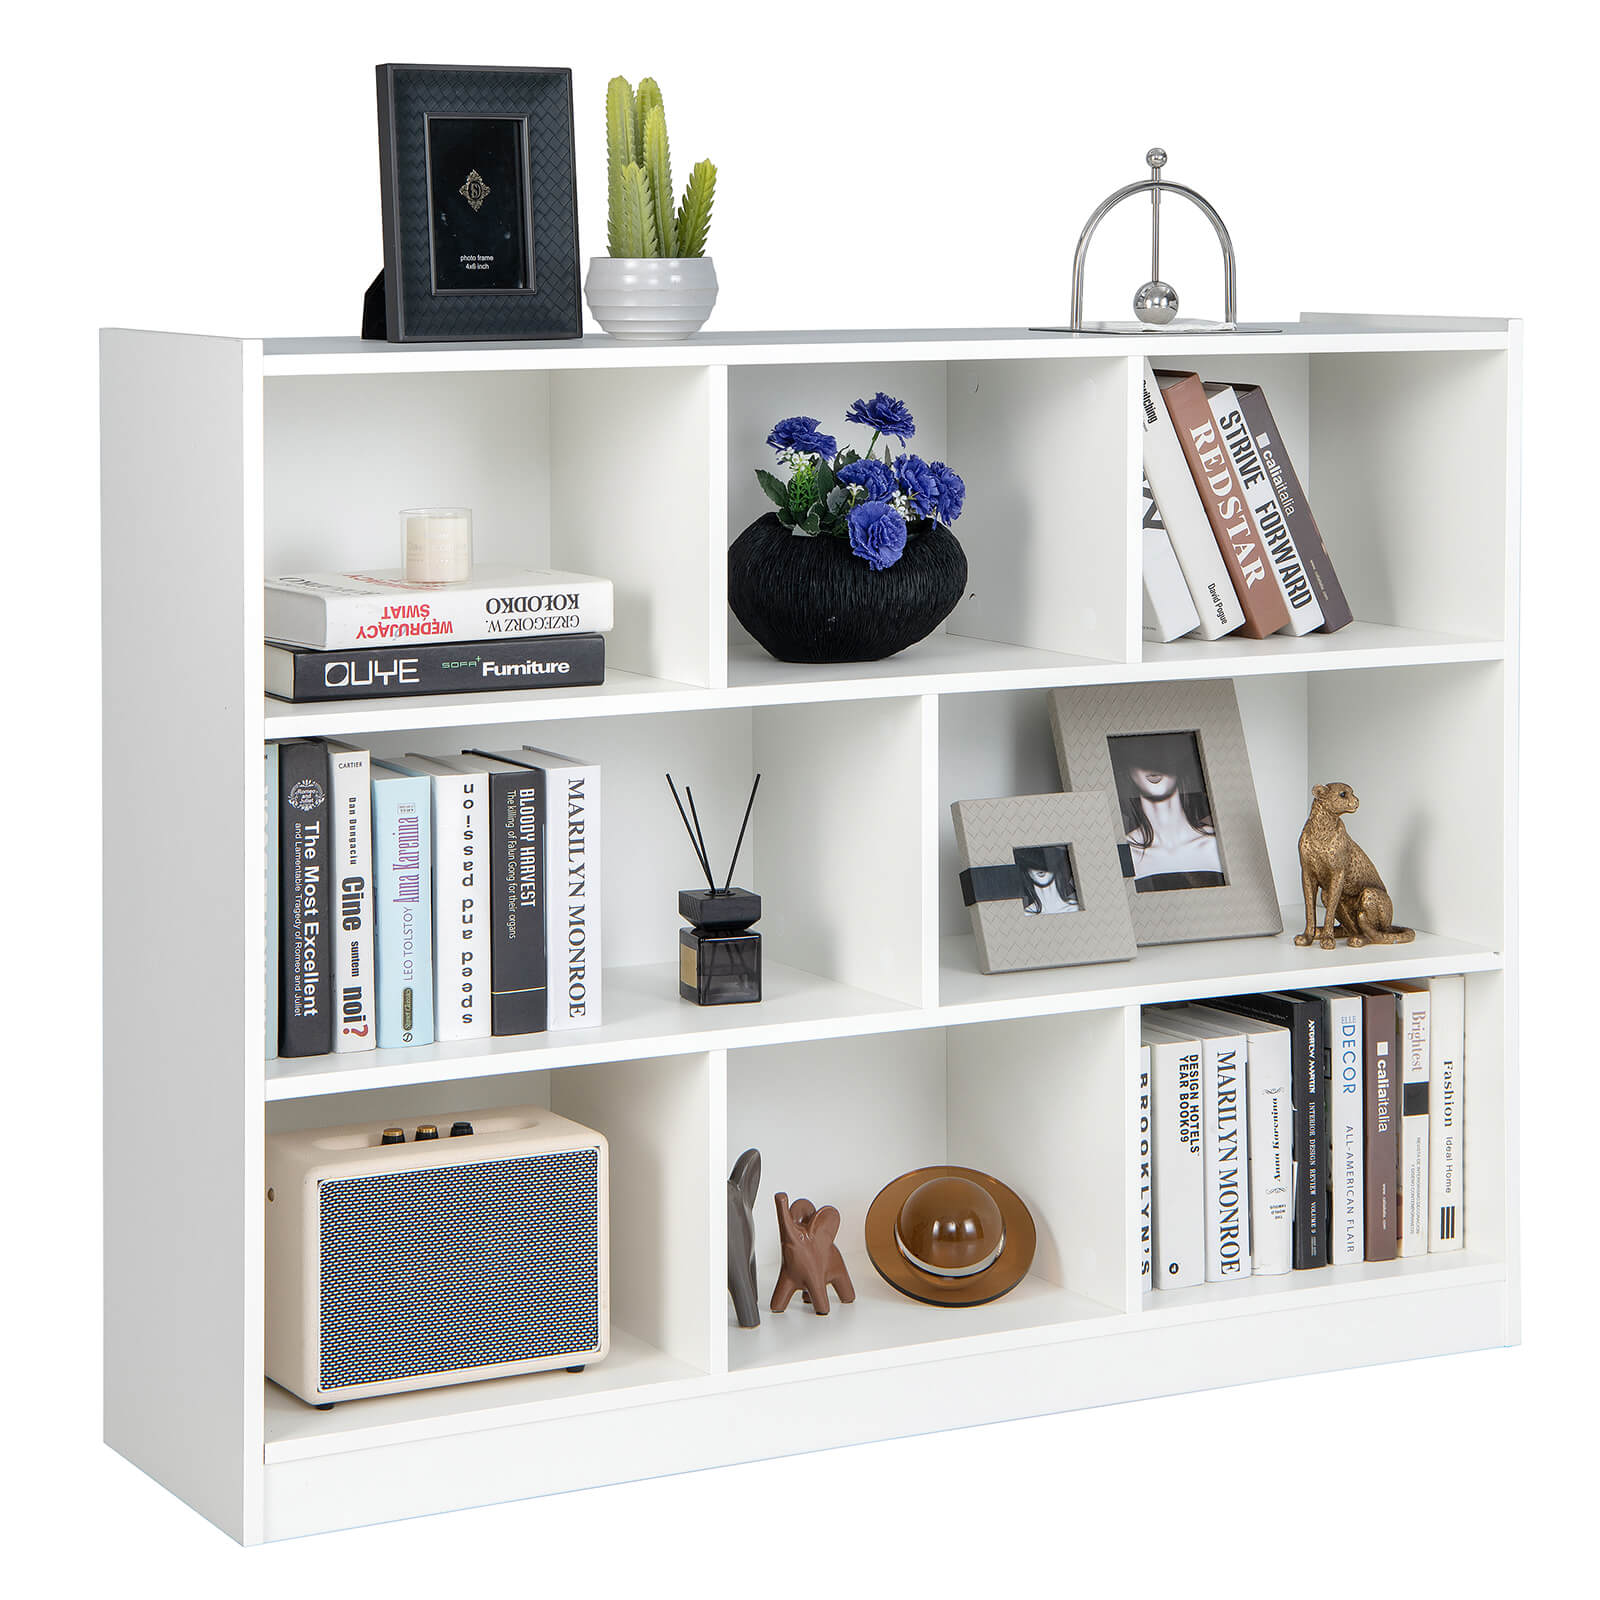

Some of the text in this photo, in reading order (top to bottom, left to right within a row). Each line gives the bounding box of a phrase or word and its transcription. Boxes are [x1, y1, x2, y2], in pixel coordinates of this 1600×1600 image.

[460, 254, 477, 262] photo
[1219, 410, 1313, 610] STRIVE FORWARD
[1263, 450, 1295, 517] caliaitalia
[356, 620, 454, 640] WĘDRUJĄCY
[381, 603, 431, 620] ŚWIAT
[485, 614, 580, 633] GRZEGORZ W.
[486, 593, 580, 614] KOŁODKO
[1208, 583, 1228, 625] David Pogue
[482, 660, 571, 677] Furniture
[338, 761, 363, 769] CARTIER
[348, 797, 357, 815] Dan
[392, 816, 420, 871] Karenina
[505, 790, 517, 940] The killing of Falun Gong for their organs
[519, 788, 536, 908] BLOODY HARVEST
[293, 893, 302, 929] Tragedy
[342, 876, 366, 932] Cine
[392, 873, 420, 903] Anna
[462, 783, 474, 1024] speed and passion
[568, 777, 586, 1018] MARILYN MONROE
[294, 930, 302, 940] of
[303, 820, 320, 1017] The Most Excellent
[403, 906, 414, 981] LEO TOLSTOY
[294, 941, 302, 972] Romeo
[294, 975, 302, 991] and
[350, 941, 361, 977] suntem
[294, 993, 302, 1017] Juliet
[343, 986, 369, 1037] noi?
[1308, 1019, 1316, 1094] ANDREW MARTIN
[1341, 1024, 1357, 1094] DECOR
[1407, 1010, 1426, 1072] Brightest
[1179, 1055, 1189, 1143] YEAR BOOK09
[1190, 1054, 1200, 1153] DESIGN HOTELS
[1377, 1059, 1388, 1133] caliaitalia
[1271, 1097, 1281, 1182] Anna Karenina
[1441, 1059, 1454, 1194] Fashion Ideal Home
[1216, 1050, 1241, 1275] MARILYN MONROE
[1309, 1168, 1317, 1196] REVIEW
[1345, 1125, 1355, 1254] ALL-AMERICAN FLAIR
